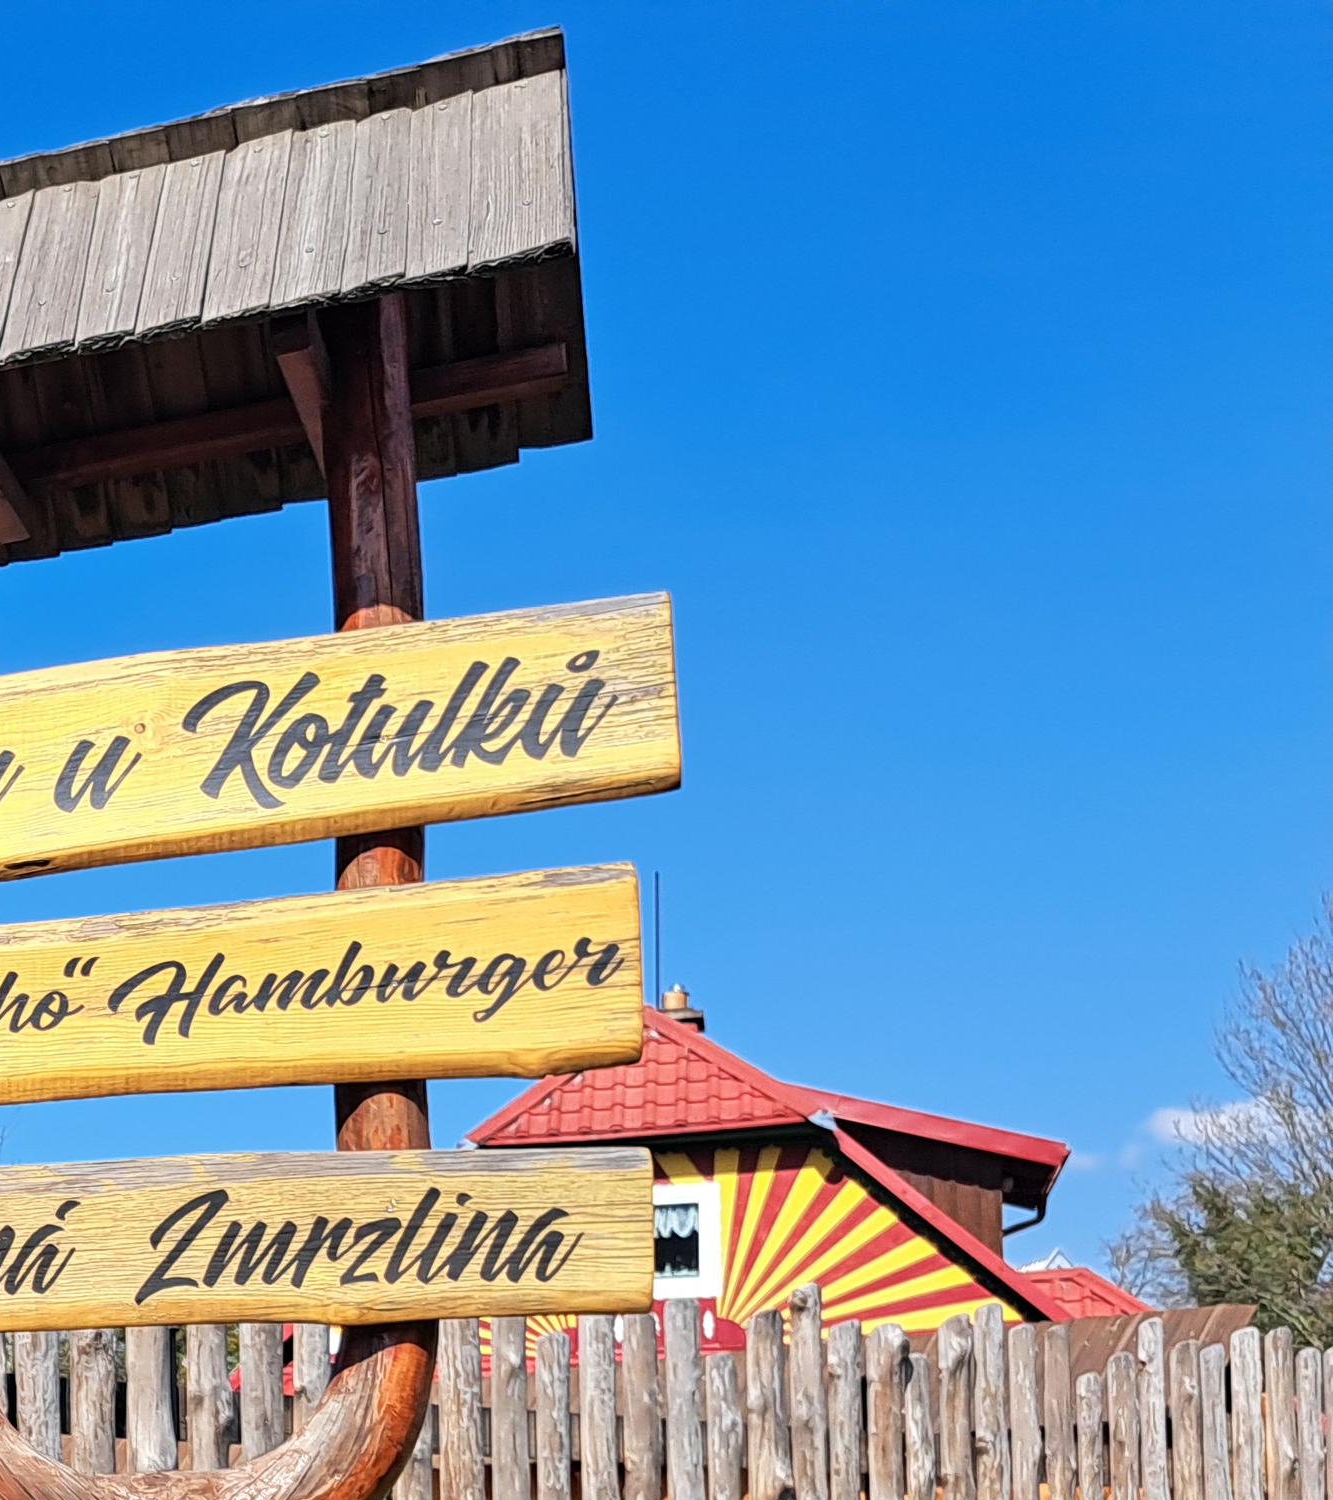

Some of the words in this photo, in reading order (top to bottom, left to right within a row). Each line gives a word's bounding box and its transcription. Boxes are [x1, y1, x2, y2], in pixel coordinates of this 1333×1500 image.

[53, 735, 142, 813] u
[181, 649, 619, 809] Kotulků
[107, 936, 625, 1046] Hamburger
[134, 1186, 584, 1306] Zmrzlina
